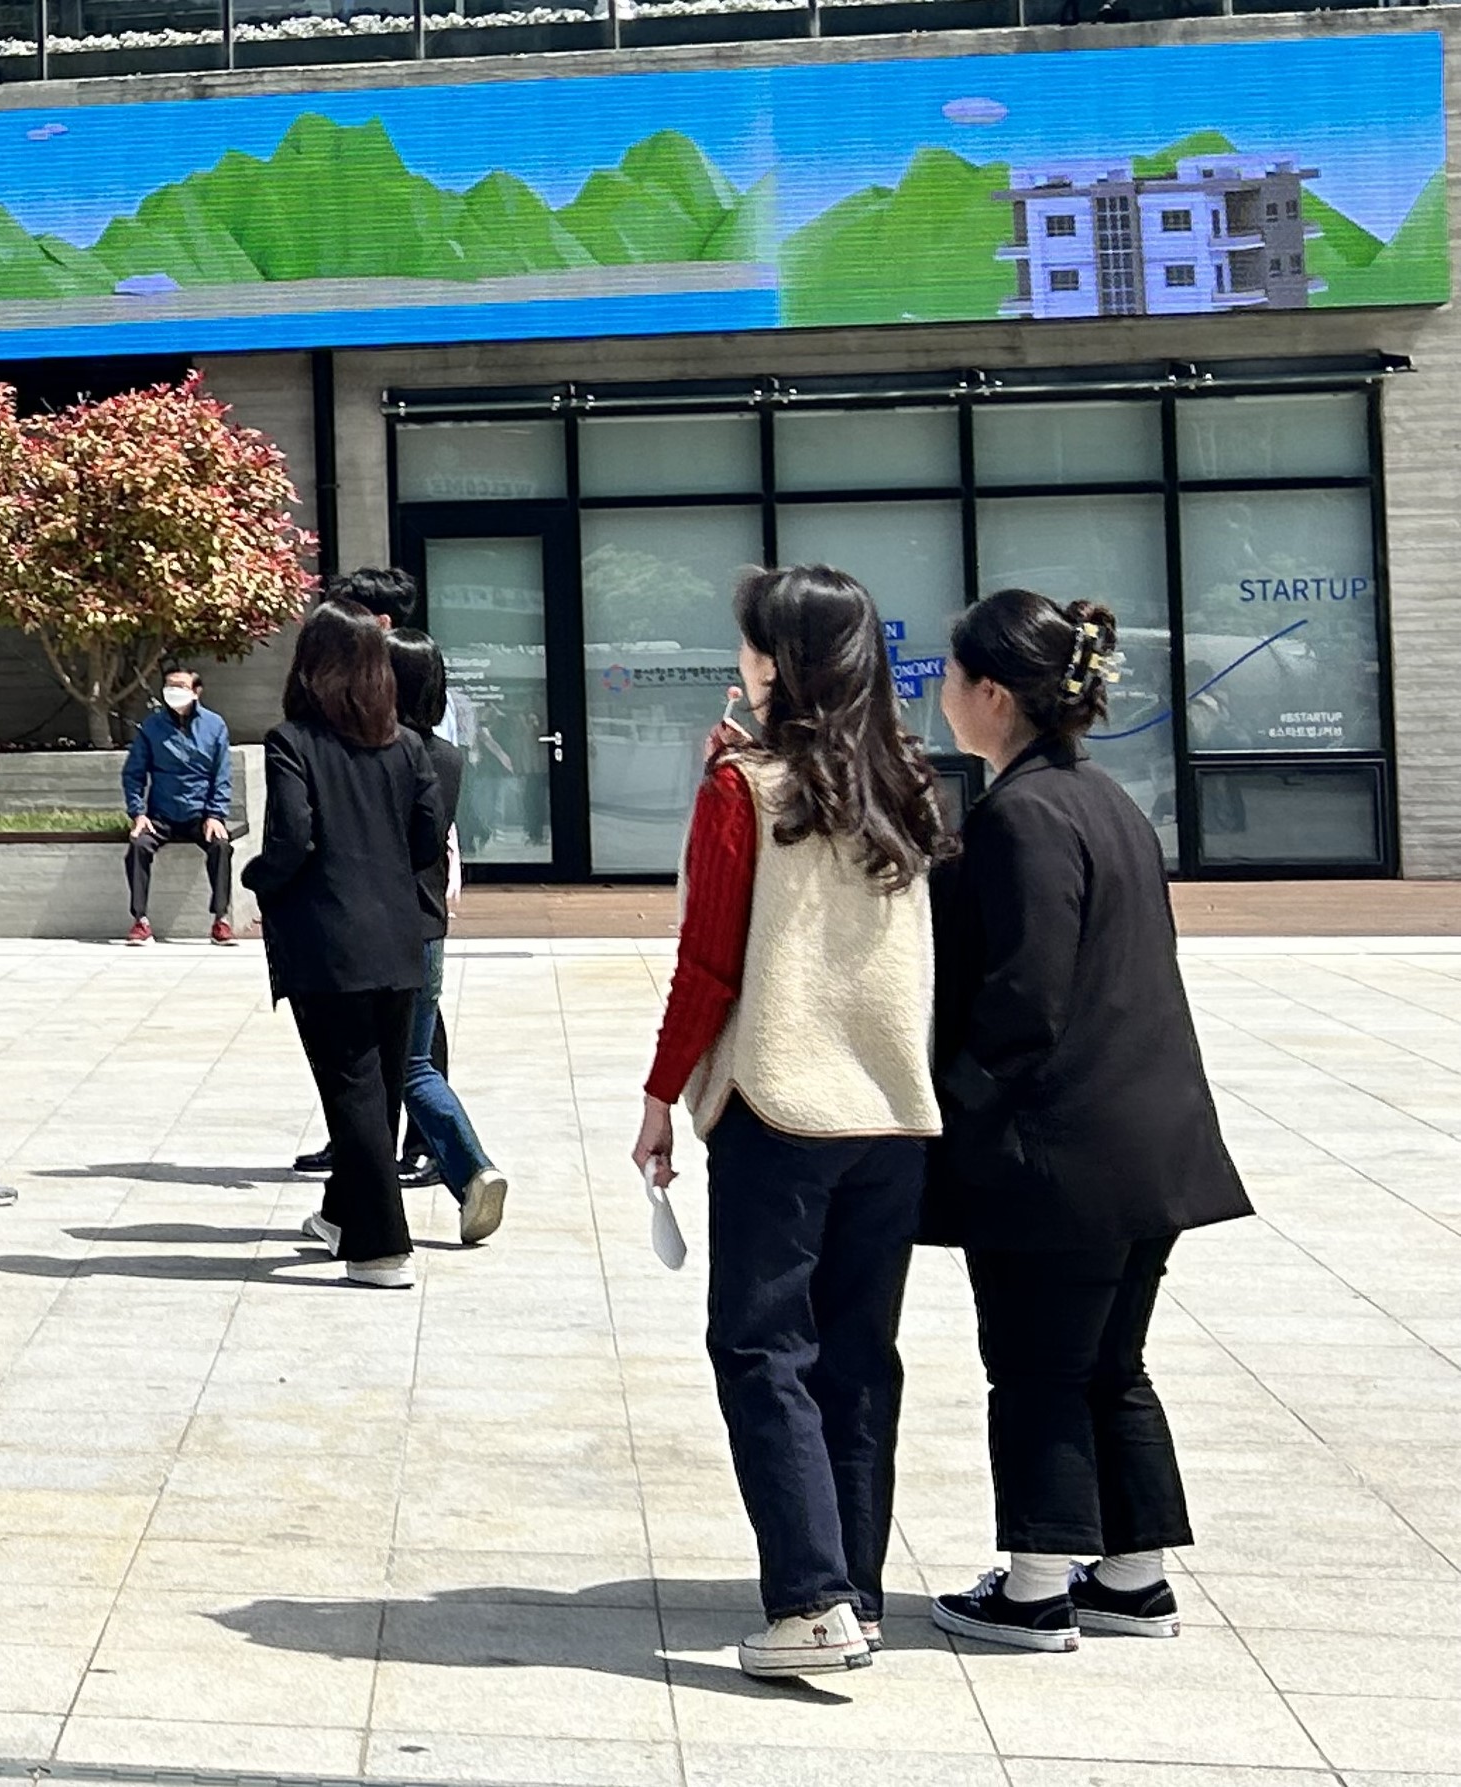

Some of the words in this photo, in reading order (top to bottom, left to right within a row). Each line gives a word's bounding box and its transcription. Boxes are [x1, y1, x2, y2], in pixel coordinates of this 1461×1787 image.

[1240, 577, 1368, 602] STARTUP
[634, 666, 739, 682] 부산창조경제혁신센
[891, 660, 940, 678] ONOMY
